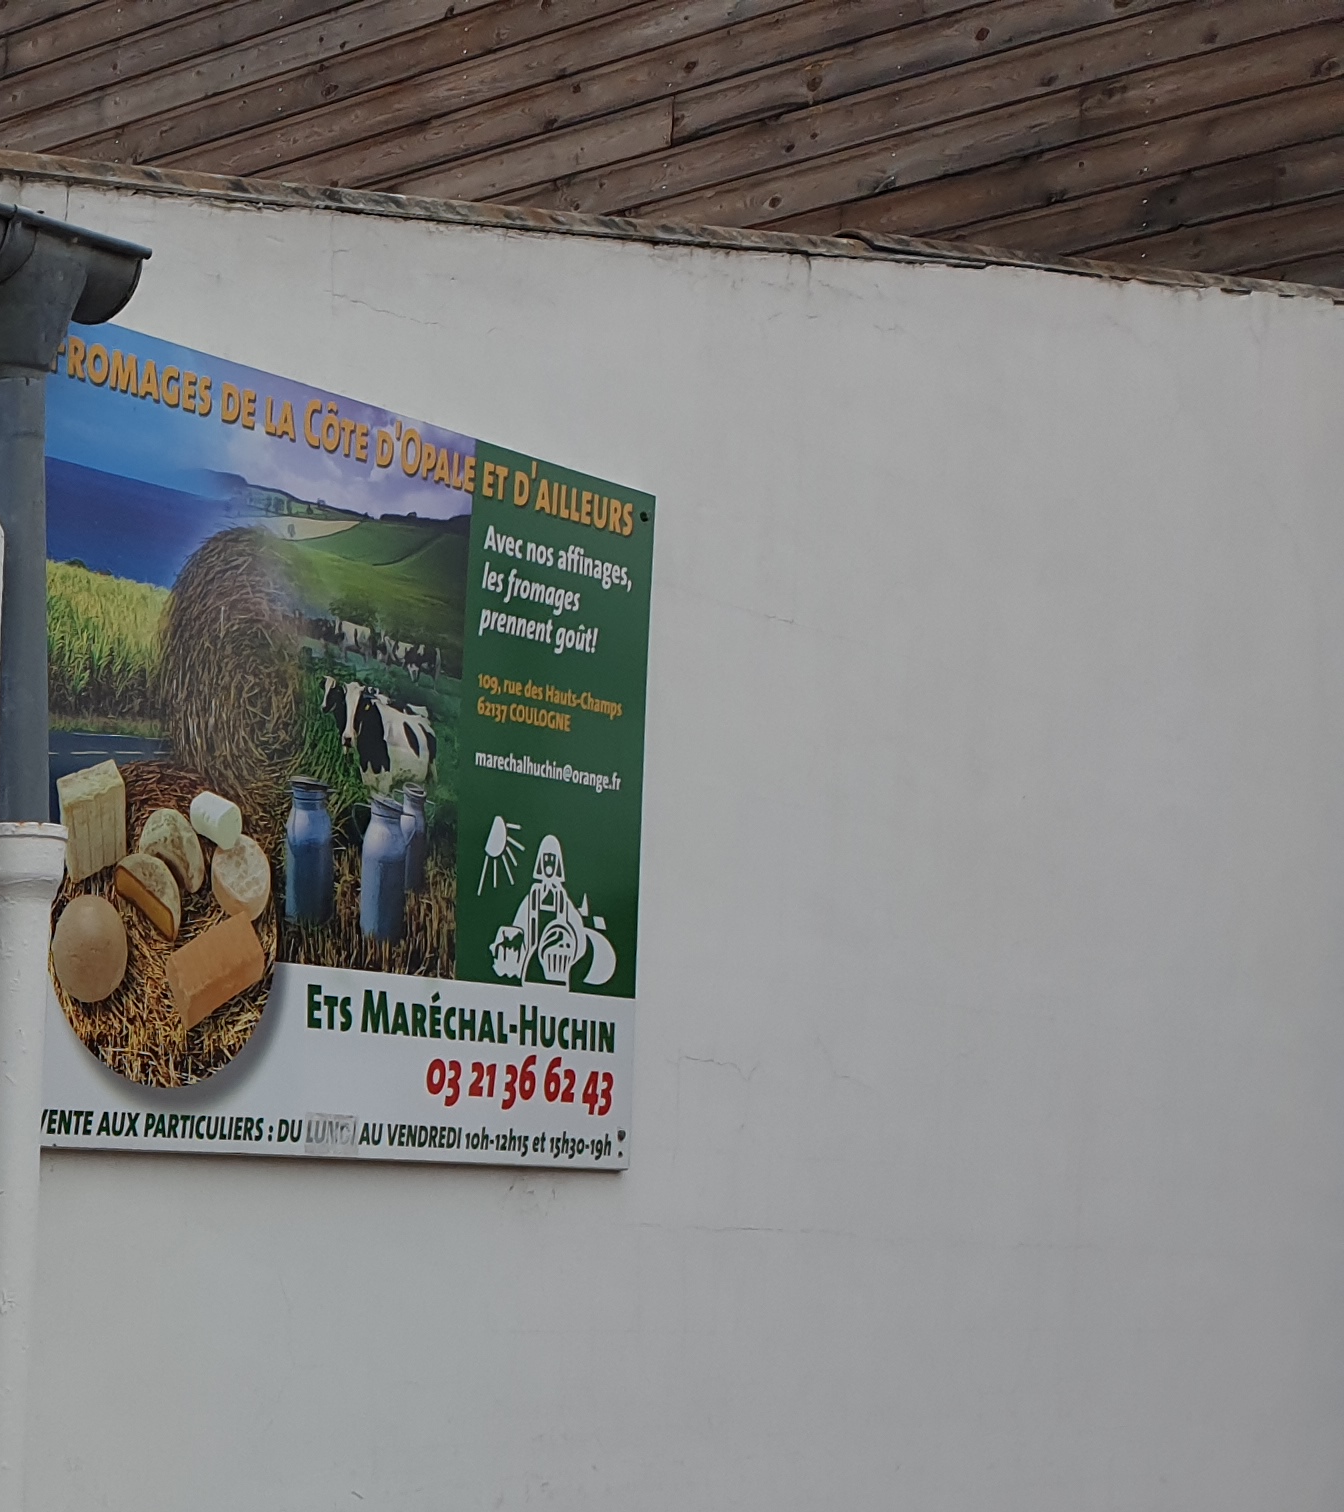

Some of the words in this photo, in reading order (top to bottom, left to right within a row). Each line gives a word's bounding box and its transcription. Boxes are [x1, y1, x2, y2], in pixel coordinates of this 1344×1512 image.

[221, 382, 257, 430] DE
[264, 396, 297, 442] LA
[303, 400, 369, 463] CÔTE
[375, 420, 476, 494] D'OPALE
[482, 461, 509, 501] ET
[513, 461, 634, 537] D'AILLEURS
[483, 525, 523, 559] Avec
[526, 541, 554, 567] nos
[557, 545, 632, 592] affinages,
[481, 561, 505, 593] les
[503, 568, 580, 616] fromages
[478, 608, 554, 644] prennent
[554, 624, 599, 654] goût!
[477, 673, 501, 695] 109,
[503, 679, 522, 696] rue
[524, 679, 543, 700] des
[545, 684, 623, 720] Hauts-Champs
[477, 696, 507, 724] 62137
[509, 703, 572, 732] COULOGNE
[475, 751, 622, 793] marechalhuchin@orange.fr
[426, 1058, 462, 1107] 03
[468, 1061, 497, 1098] 21
[501, 1054, 537, 1110] 36
[543, 1056, 576, 1103] 62
[581, 1070, 614, 1116] 43
[96, 1111, 140, 1137] AUX
[143, 1113, 264, 1142] PARTICULIERS
[276, 1118, 303, 1143] DU
[359, 1122, 384, 1146] AU
[387, 1123, 462, 1149] VENDREDI
[465, 1126, 529, 1157] 10h-12h15
[532, 1132, 547, 1153] et
[550, 1131, 612, 1160] 15h30-19h
